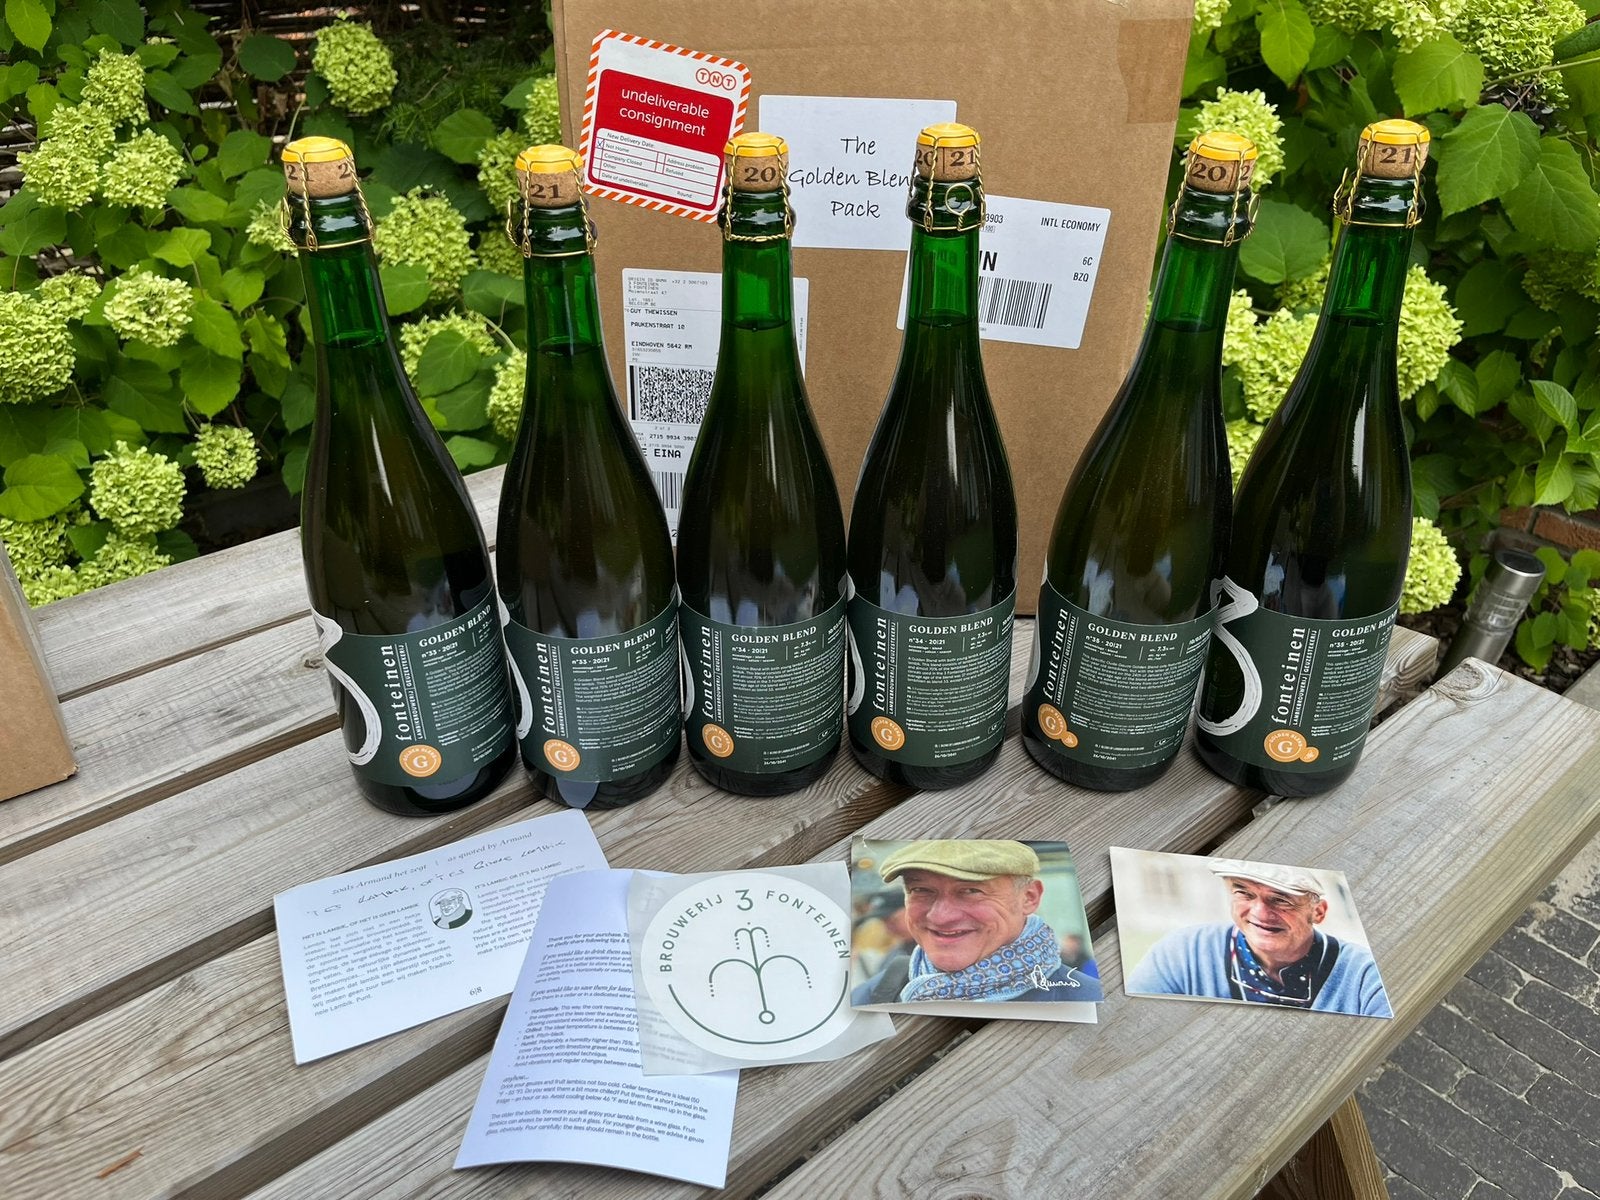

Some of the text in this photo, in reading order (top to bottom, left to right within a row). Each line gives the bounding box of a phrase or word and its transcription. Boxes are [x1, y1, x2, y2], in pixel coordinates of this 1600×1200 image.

[697, 69, 736, 90] TNT
[621, 89, 709, 118] undeliverable
[620, 107, 705, 136] consignment
[607, 132, 619, 141] New
[620, 135, 641, 146] Delivery
[841, 136, 876, 155] The
[615, 145, 630, 153] Home
[1381, 146, 1412, 164] 21
[604, 153, 643, 166] Company Closed
[744, 167, 776, 183] 20
[789, 166, 911, 189] Golden Blen
[1192, 162, 1227, 182] 20
[531, 184, 565, 199] 21
[831, 200, 881, 218] Pack
[1041, 217, 1058, 228] INTL
[1061, 219, 1101, 232] ECONOMY
[1082, 257, 1093, 266] 6C
[1073, 272, 1089, 282] BZQ
[631, 341, 664, 349] EINDHOVEN
[654, 448, 681, 458] EINA
[419, 604, 492, 648] GOLDEN BLEND
[731, 626, 817, 644] GOLDEN BLEND
[909, 616, 993, 635] GOLDEN BLEND
[1088, 622, 1178, 642] GOLDEN BLEND
[1332, 623, 1377, 638] GOLDEN
[570, 628, 656, 655] GOLDEN BLEND
[1043, 608, 1069, 700] fonteinen
[701, 626, 714, 719] fonteinen
[873, 618, 887, 711] fonteinen
[1271, 628, 1305, 725] fonteinen
[380, 644, 412, 741] fonteinen
[536, 642, 557, 735] fonteinen
[356, 873, 392, 888] Armand
[458, 846, 486, 860] quoted
[499, 832, 532, 846] Armand
[660, 894, 723, 973] BROUWERIJ
[735, 889, 753, 911] 3
[766, 890, 850, 959] FONTEINEN
